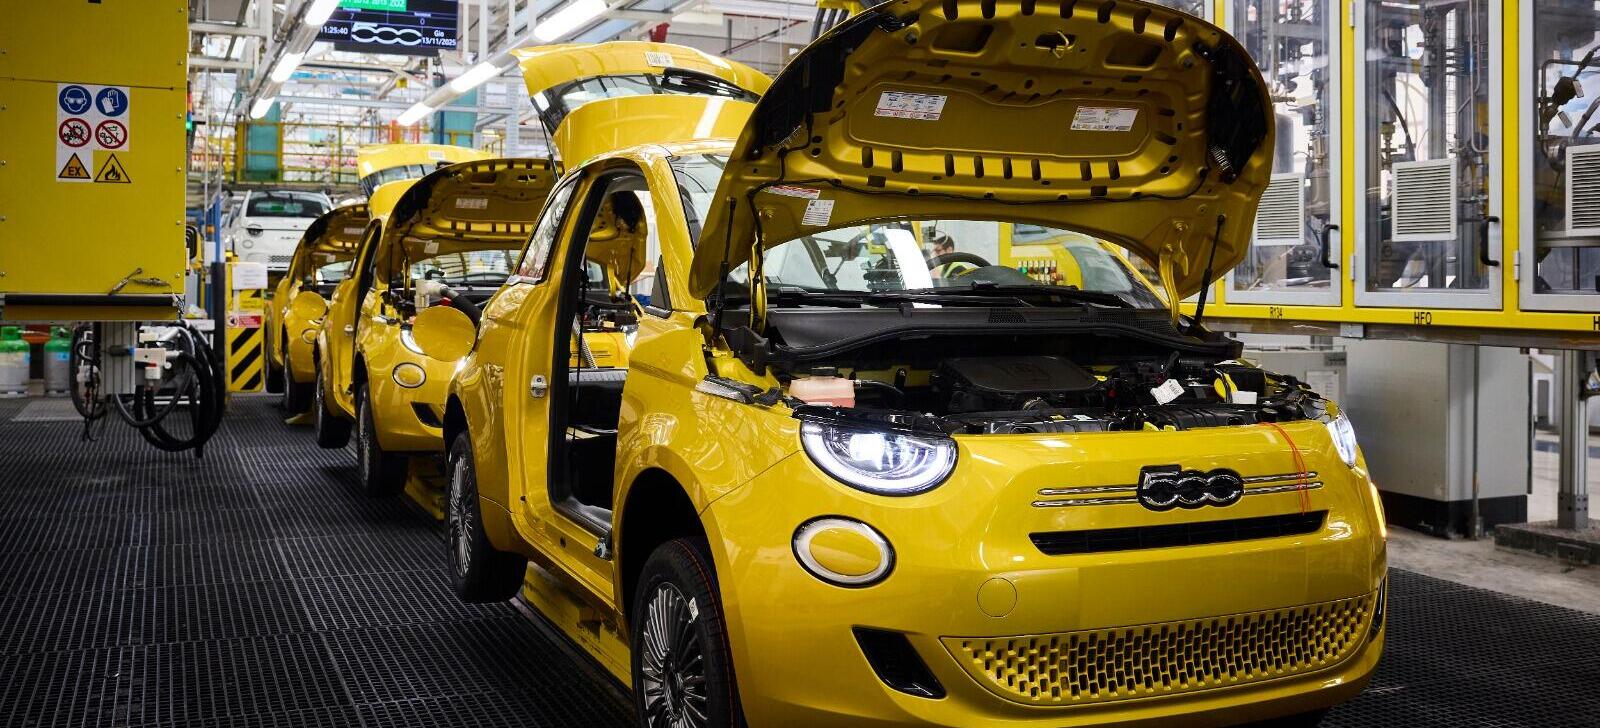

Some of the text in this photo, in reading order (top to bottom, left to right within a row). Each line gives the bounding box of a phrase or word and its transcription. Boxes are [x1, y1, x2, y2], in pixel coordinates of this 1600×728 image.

[351, 22, 422, 46] 500
[68, 166, 81, 177] EX
[1414, 311, 1432, 325] HFO
[1138, 465, 1243, 511] 500
